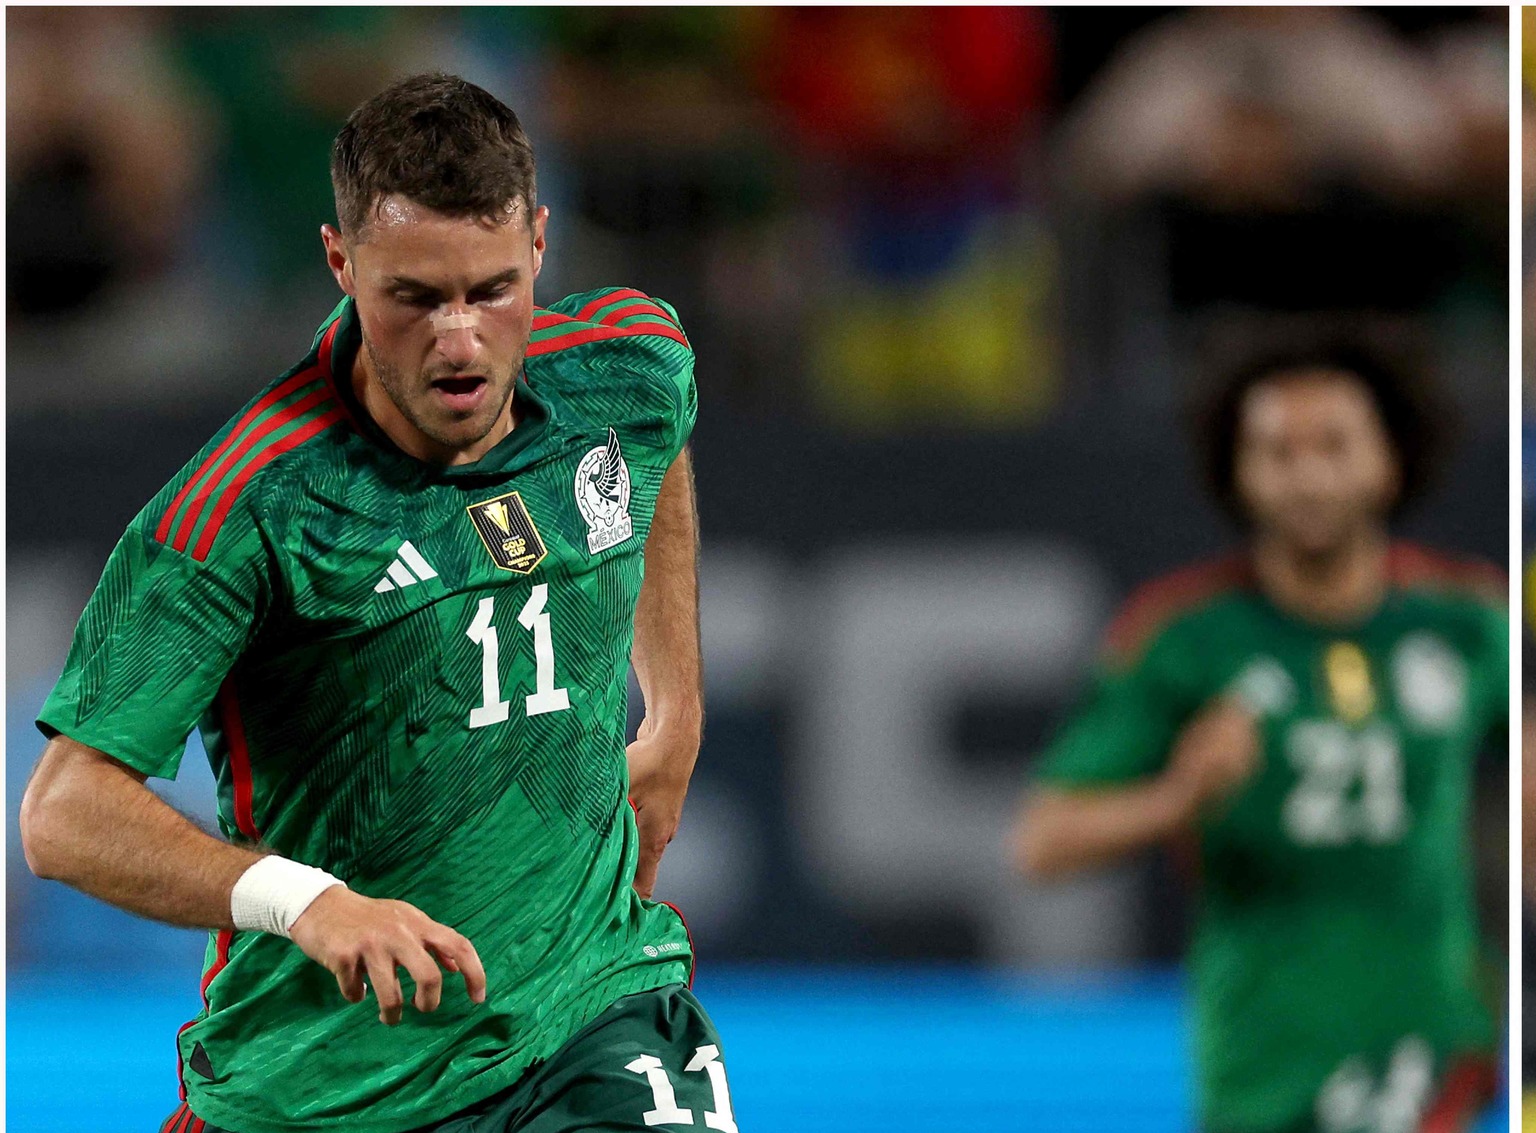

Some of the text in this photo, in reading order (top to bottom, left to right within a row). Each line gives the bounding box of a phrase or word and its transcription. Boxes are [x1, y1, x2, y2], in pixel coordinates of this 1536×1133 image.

[502, 538, 526, 551] GOLD
[588, 521, 631, 551] MÉXICO
[509, 546, 526, 557] CUP
[465, 583, 571, 729] 11
[1285, 718, 1410, 847] 21
